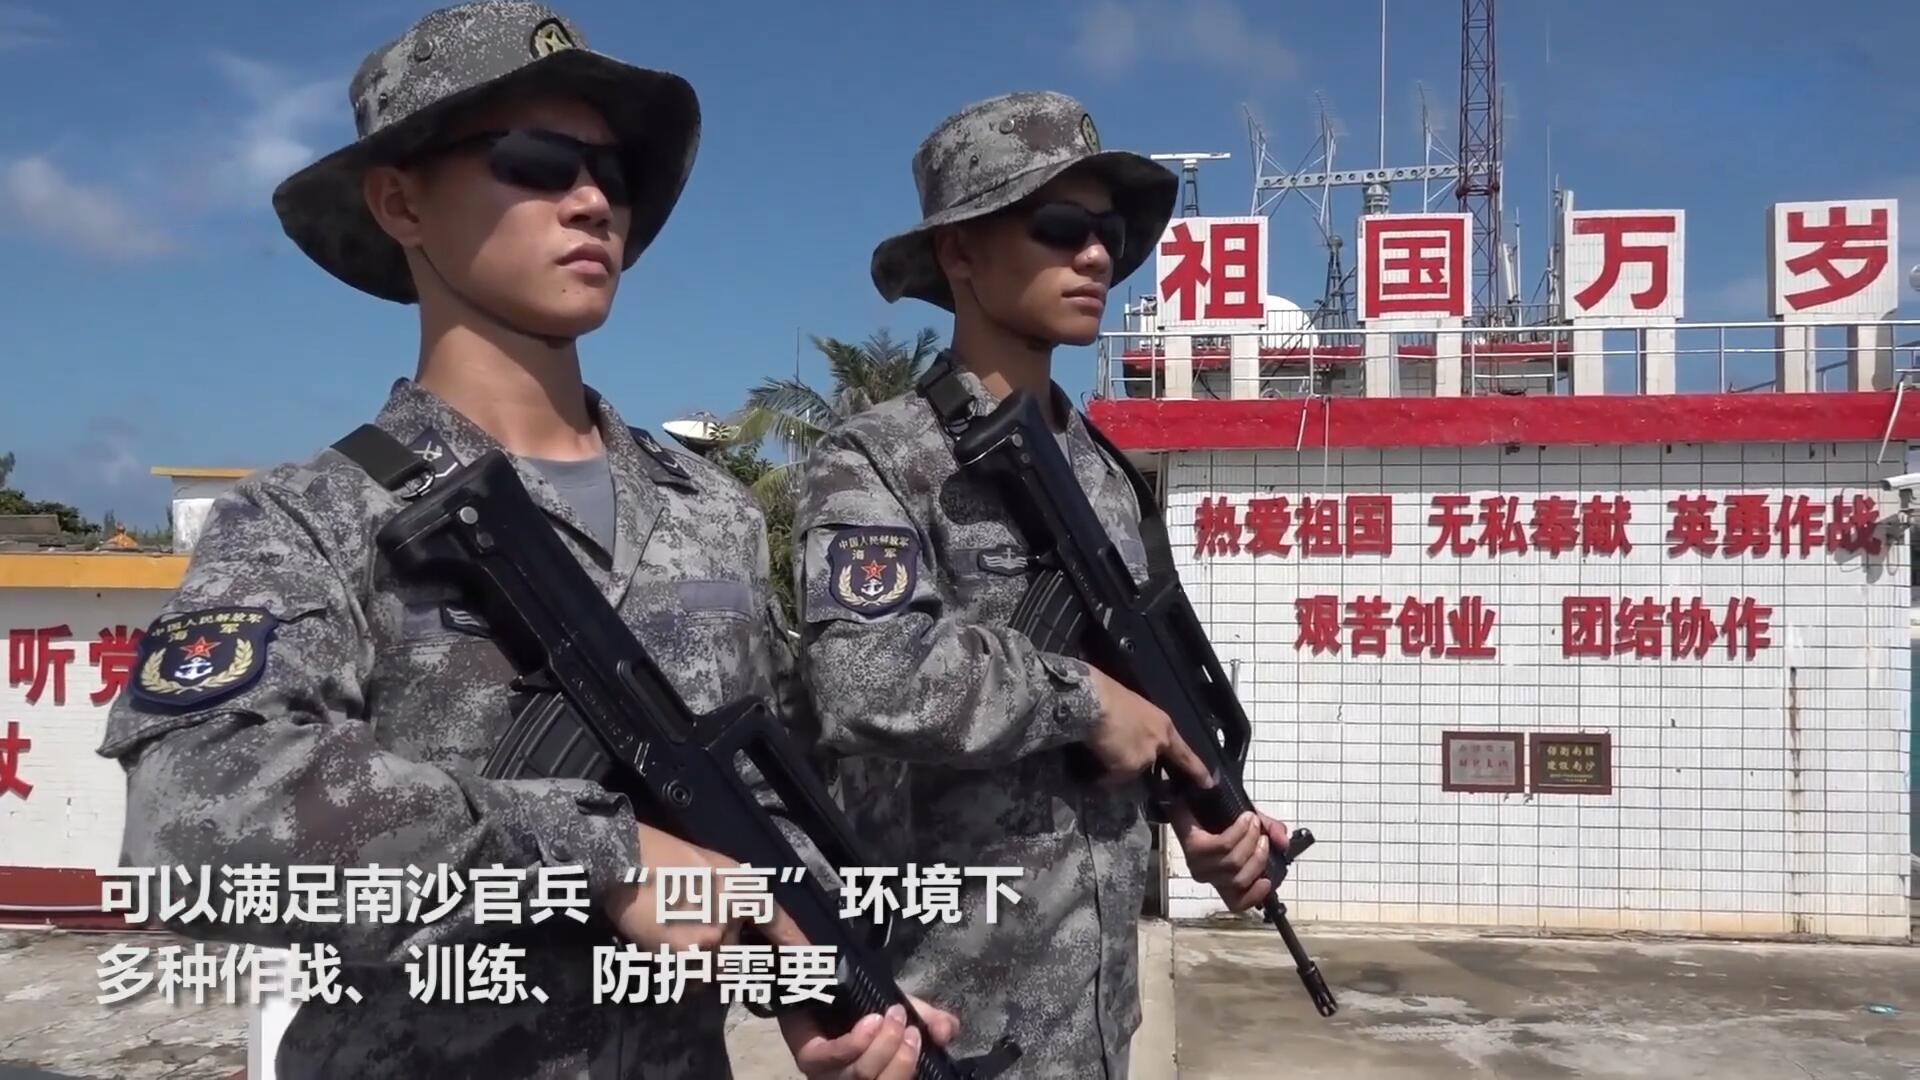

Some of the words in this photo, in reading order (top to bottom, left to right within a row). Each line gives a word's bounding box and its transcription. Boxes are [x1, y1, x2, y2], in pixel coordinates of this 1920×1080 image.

[1160, 206, 1889, 321] 祖国万岁
[852, 548, 897, 560] 海军
[1194, 494, 1394, 557] 热爱祖国
[1428, 494, 1632, 557] 无私奉献
[1667, 494, 1882, 557] 英勇作战
[1294, 595, 1497, 660] 艰苦创业
[1561, 595, 1773, 660] 团结协作
